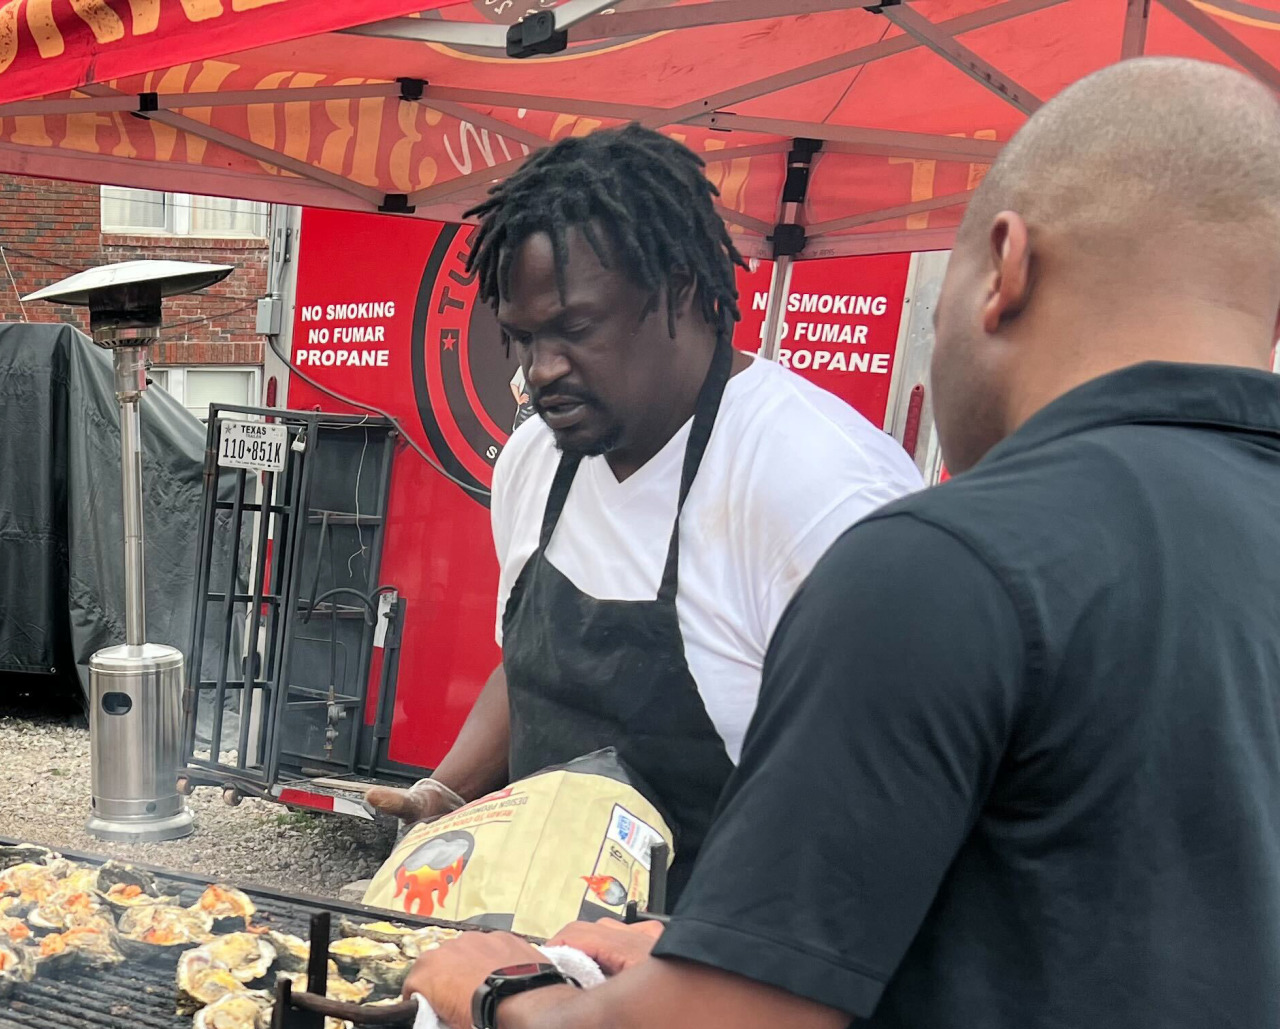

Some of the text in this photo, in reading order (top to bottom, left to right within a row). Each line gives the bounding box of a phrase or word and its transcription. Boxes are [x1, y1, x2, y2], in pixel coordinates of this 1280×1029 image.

[301, 301, 395, 321] NO SMOKING
[787, 293, 888, 316] SMOKING
[308, 326, 385, 344] NO FUMAR
[794, 322, 869, 344] FUMAR
[296, 349, 389, 367] PROPANE
[757, 348, 891, 374] ROPANE
[241, 425, 267, 435] TEXAS
